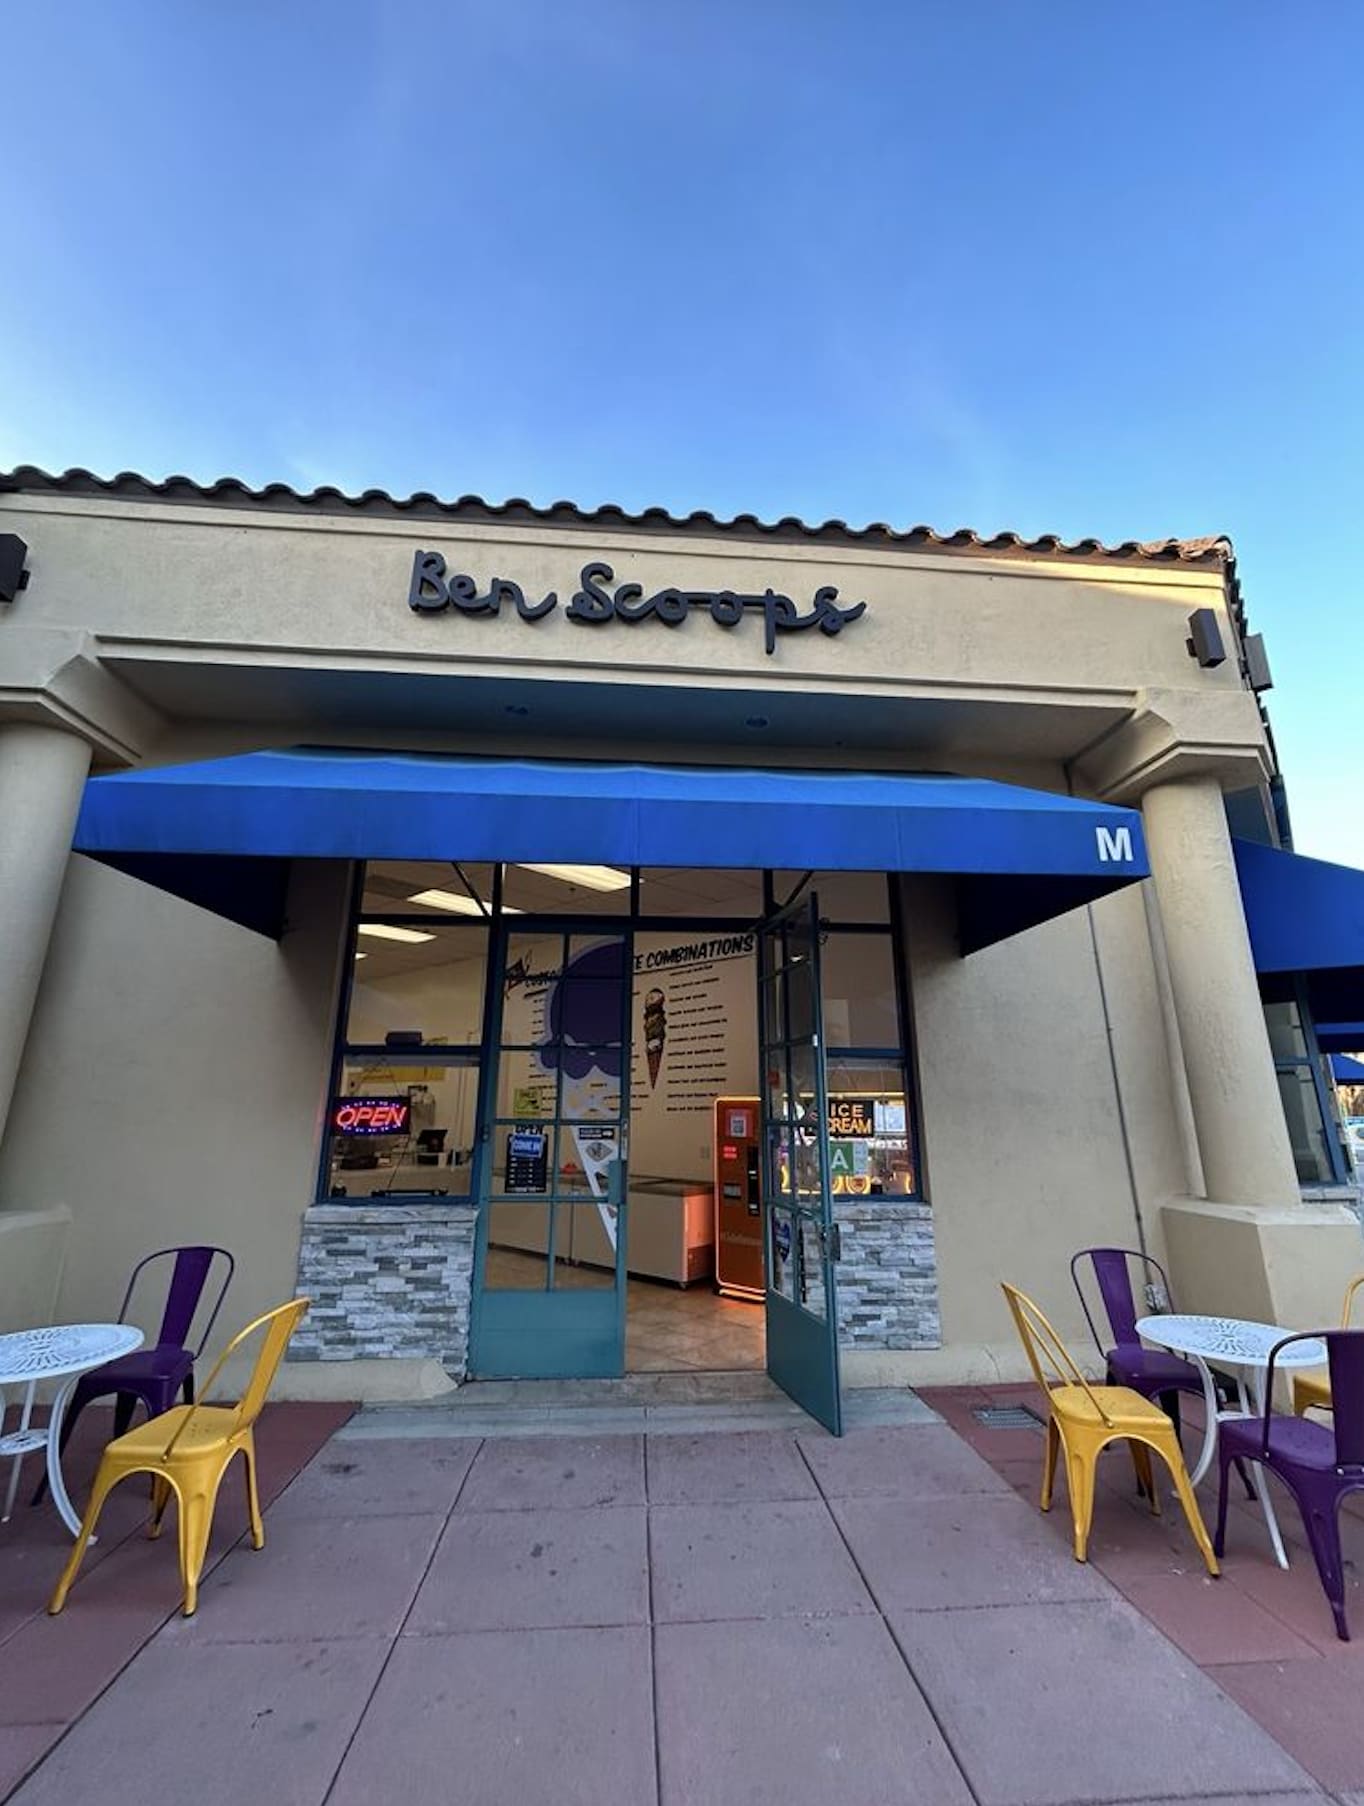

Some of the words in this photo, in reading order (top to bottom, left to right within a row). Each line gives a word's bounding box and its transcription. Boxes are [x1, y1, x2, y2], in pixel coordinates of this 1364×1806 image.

[409, 550, 558, 622] Ben
[566, 563, 867, 655] Scoops
[1096, 827, 1133, 861] M
[646, 934, 754, 968] COMBINATIONS
[336, 1106, 407, 1127] OPEN
[830, 1103, 864, 1117] ICE
[831, 1148, 848, 1169] A
